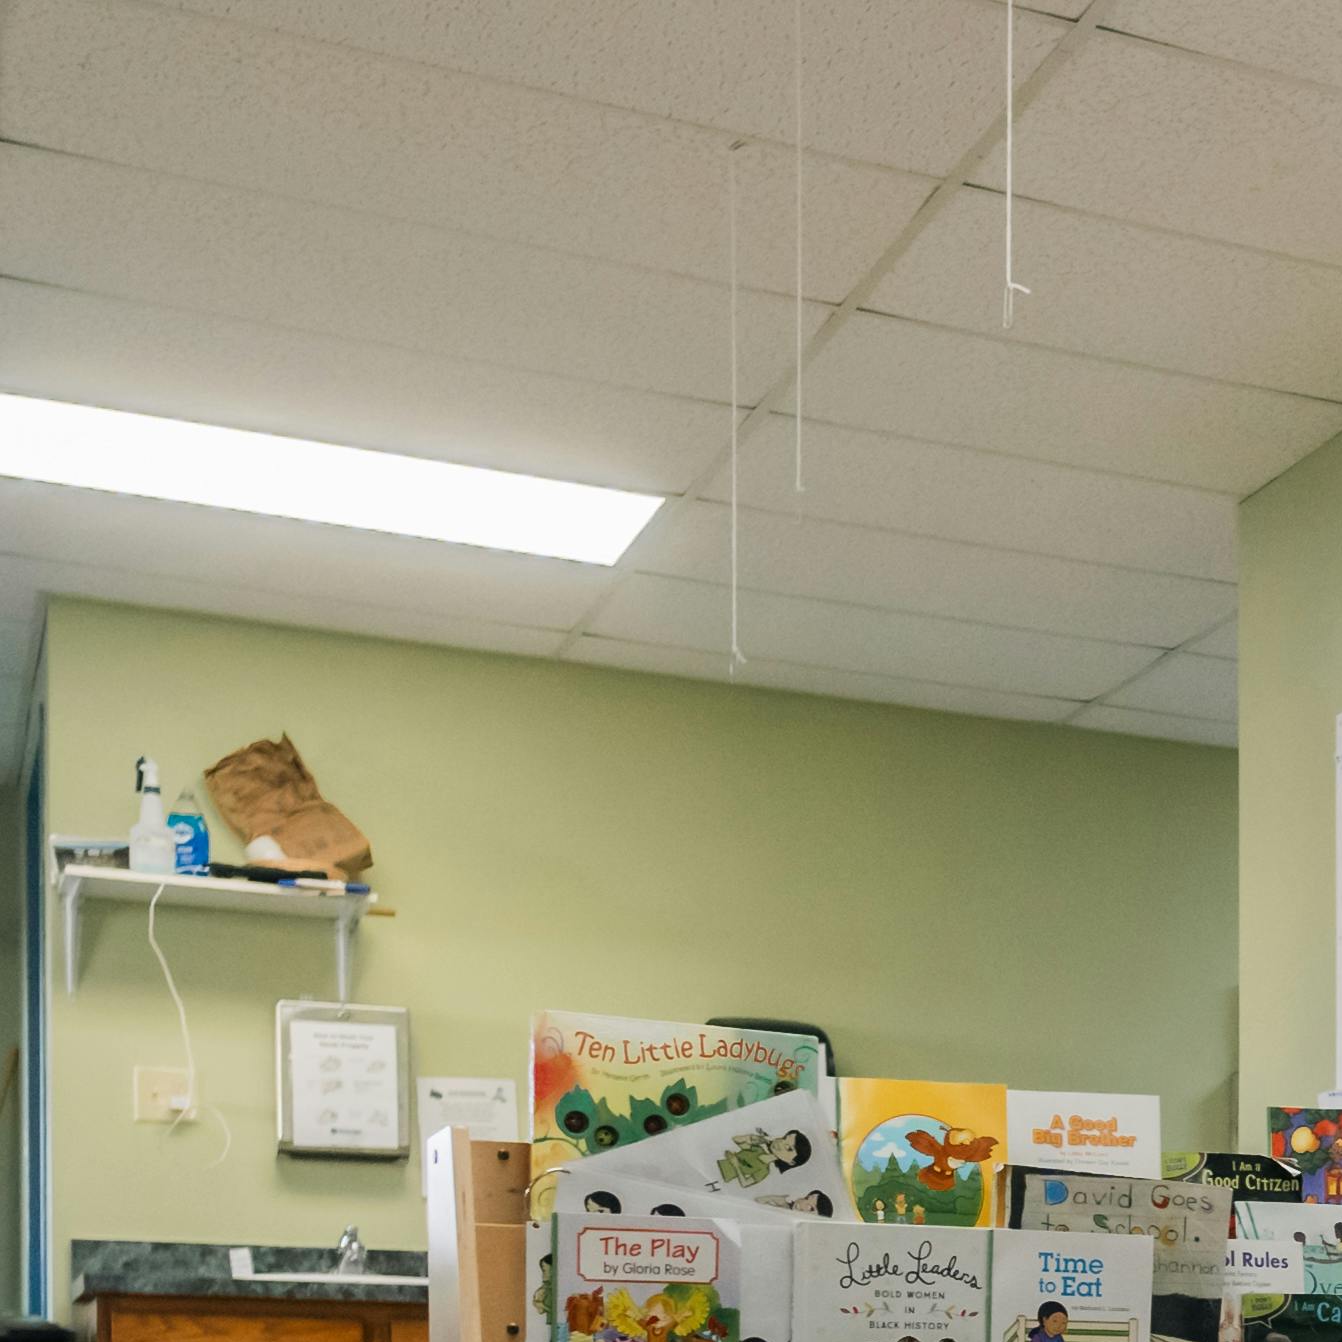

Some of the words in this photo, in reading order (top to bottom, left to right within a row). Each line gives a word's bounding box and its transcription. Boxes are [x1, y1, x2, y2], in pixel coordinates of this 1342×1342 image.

[575, 1031, 616, 1063] Ten
[623, 1037, 693, 1064] Little
[699, 1034, 805, 1074] Ladybugs
[1050, 1114, 1064, 1129] A
[1068, 1114, 1117, 1132] Good
[1032, 1128, 1063, 1148] Big
[1202, 1170, 1239, 1188] Good
[1245, 1174, 1299, 1192] Citizen
[1043, 1180, 1133, 1210] David
[1151, 1184, 1216, 1213] Goes
[599, 1236, 641, 1257] The
[650, 1238, 700, 1263] Play
[603, 1261, 620, 1277] by
[622, 1261, 661, 1276] Gloria
[664, 1262, 696, 1276] Rose
[837, 1243, 903, 1289] Little
[904, 1240, 983, 1291] Leaders
[1039, 1252, 1103, 1275] Time
[1243, 1252, 1289, 1269] Rules
[875, 1290, 902, 1299] BOLD
[907, 1291, 945, 1300] WOMEN
[1039, 1278, 1056, 1293] to
[1061, 1277, 1102, 1297] Eat
[904, 1306, 915, 1315] IN
[869, 1320, 899, 1329] BLACK
[904, 1321, 949, 1331] HISTORY
